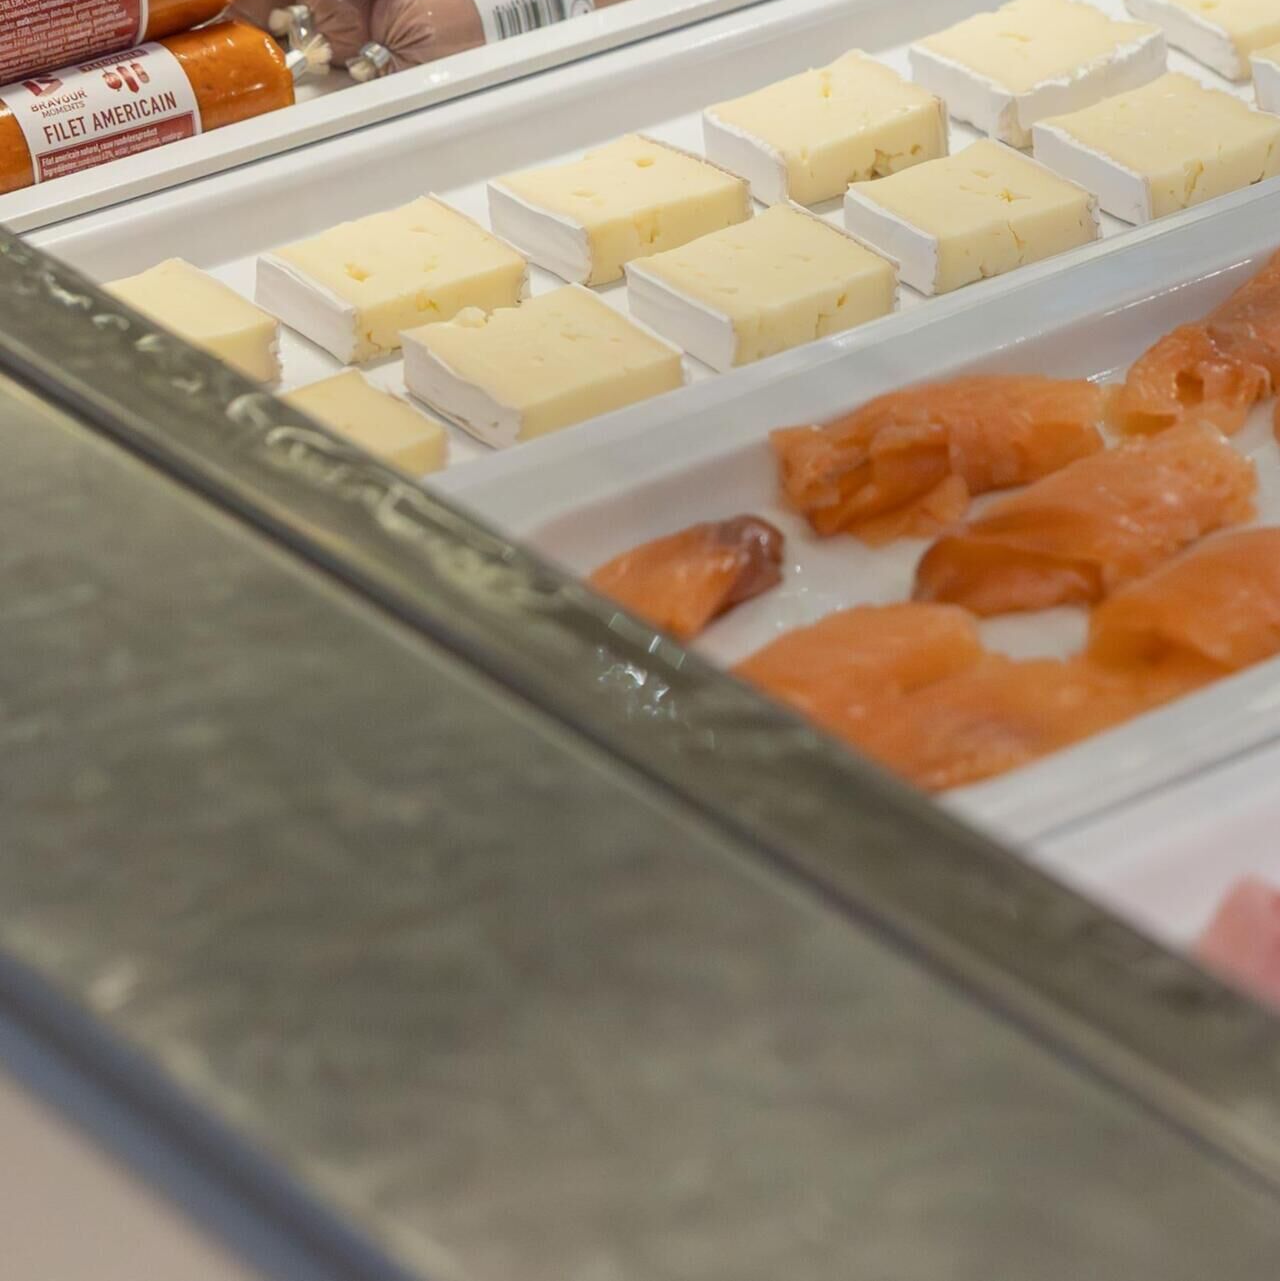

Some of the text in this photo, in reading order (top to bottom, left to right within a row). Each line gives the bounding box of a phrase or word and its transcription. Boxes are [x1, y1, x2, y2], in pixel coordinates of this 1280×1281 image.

[30, 88, 88, 113] BRAVOUR
[42, 100, 86, 118] MOMENTS
[43, 91, 177, 145] FILET AMERICAIN
